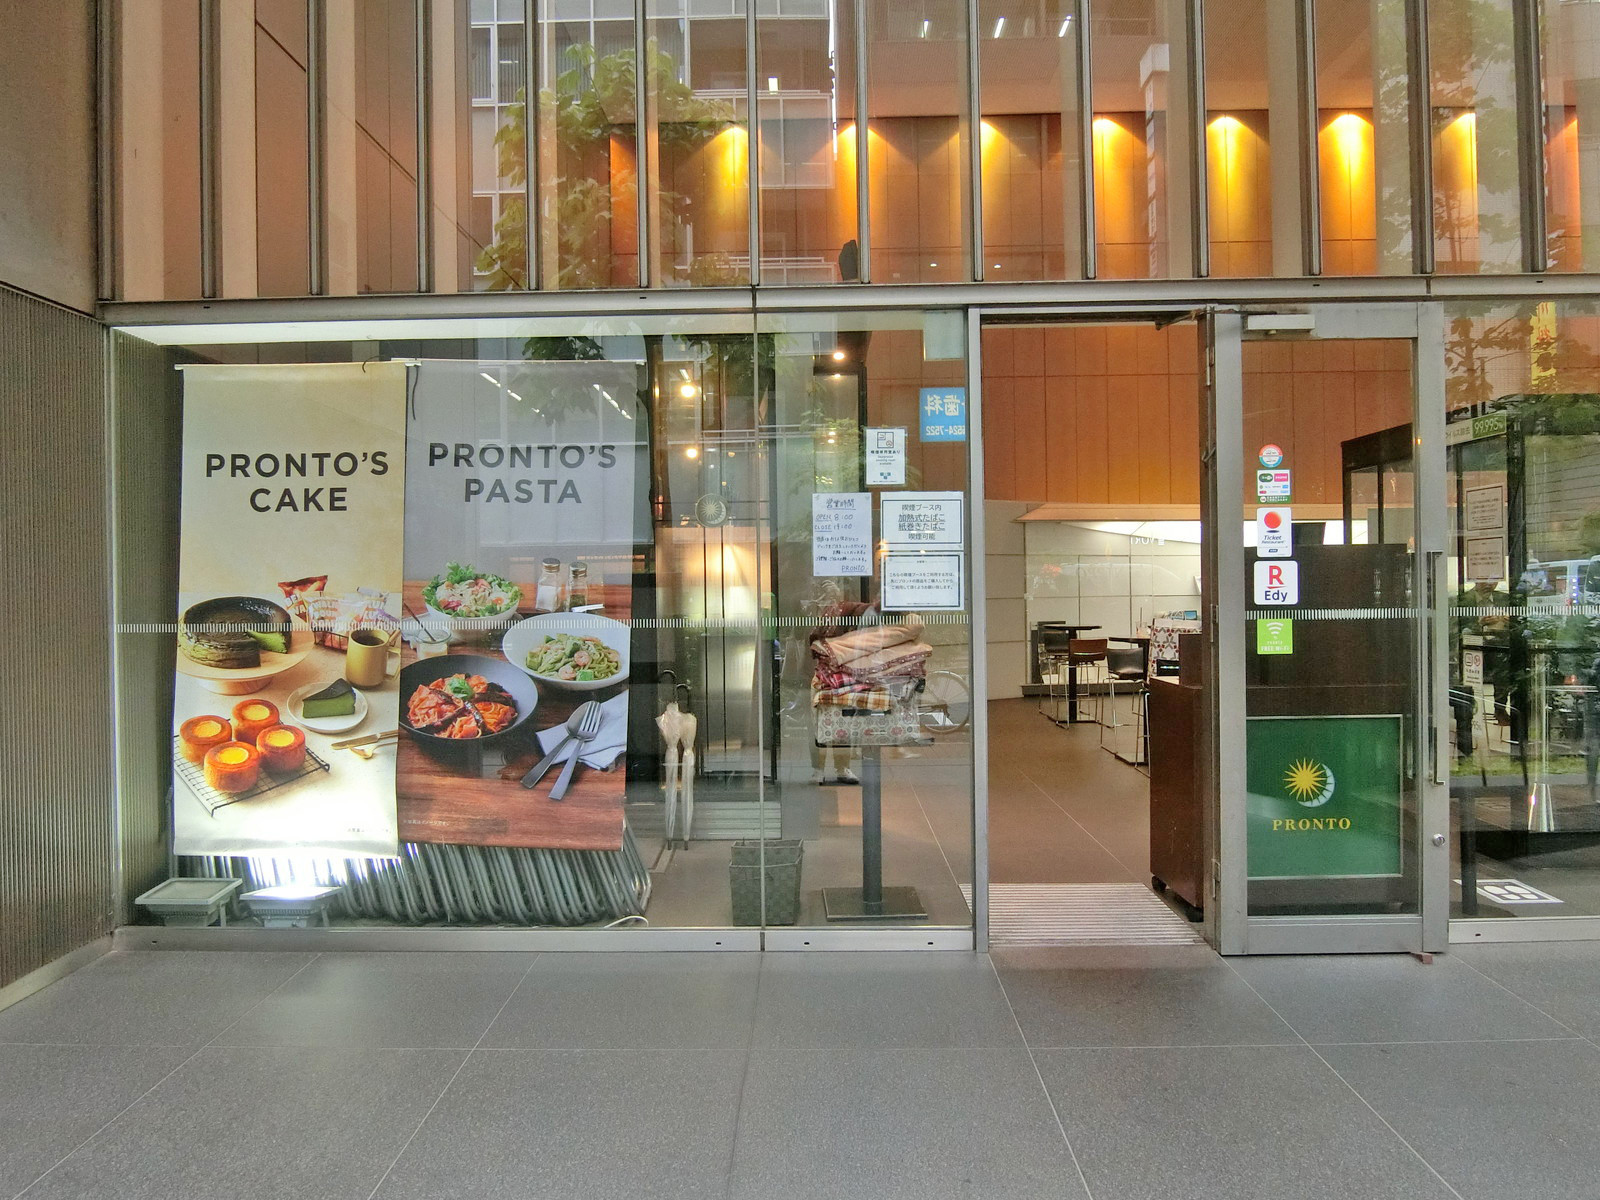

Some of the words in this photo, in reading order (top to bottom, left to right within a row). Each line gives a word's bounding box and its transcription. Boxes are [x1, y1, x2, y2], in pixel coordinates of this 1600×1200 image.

[428, 442, 617, 469] PRONTO'S
[205, 450, 389, 477] PRONTO'S
[464, 478, 582, 504] PASTA
[249, 487, 348, 512] CAKE
[901, 504, 942, 512] 喫煙ブース内
[898, 513, 946, 523] 加熱式たばこ
[898, 522, 946, 531] 紙巻きたばこ
[908, 533, 936, 541] 喫煙可能
[1268, 565, 1284, 585] R
[1264, 590, 1288, 602] Edy
[1272, 817, 1351, 831] PRONTO
